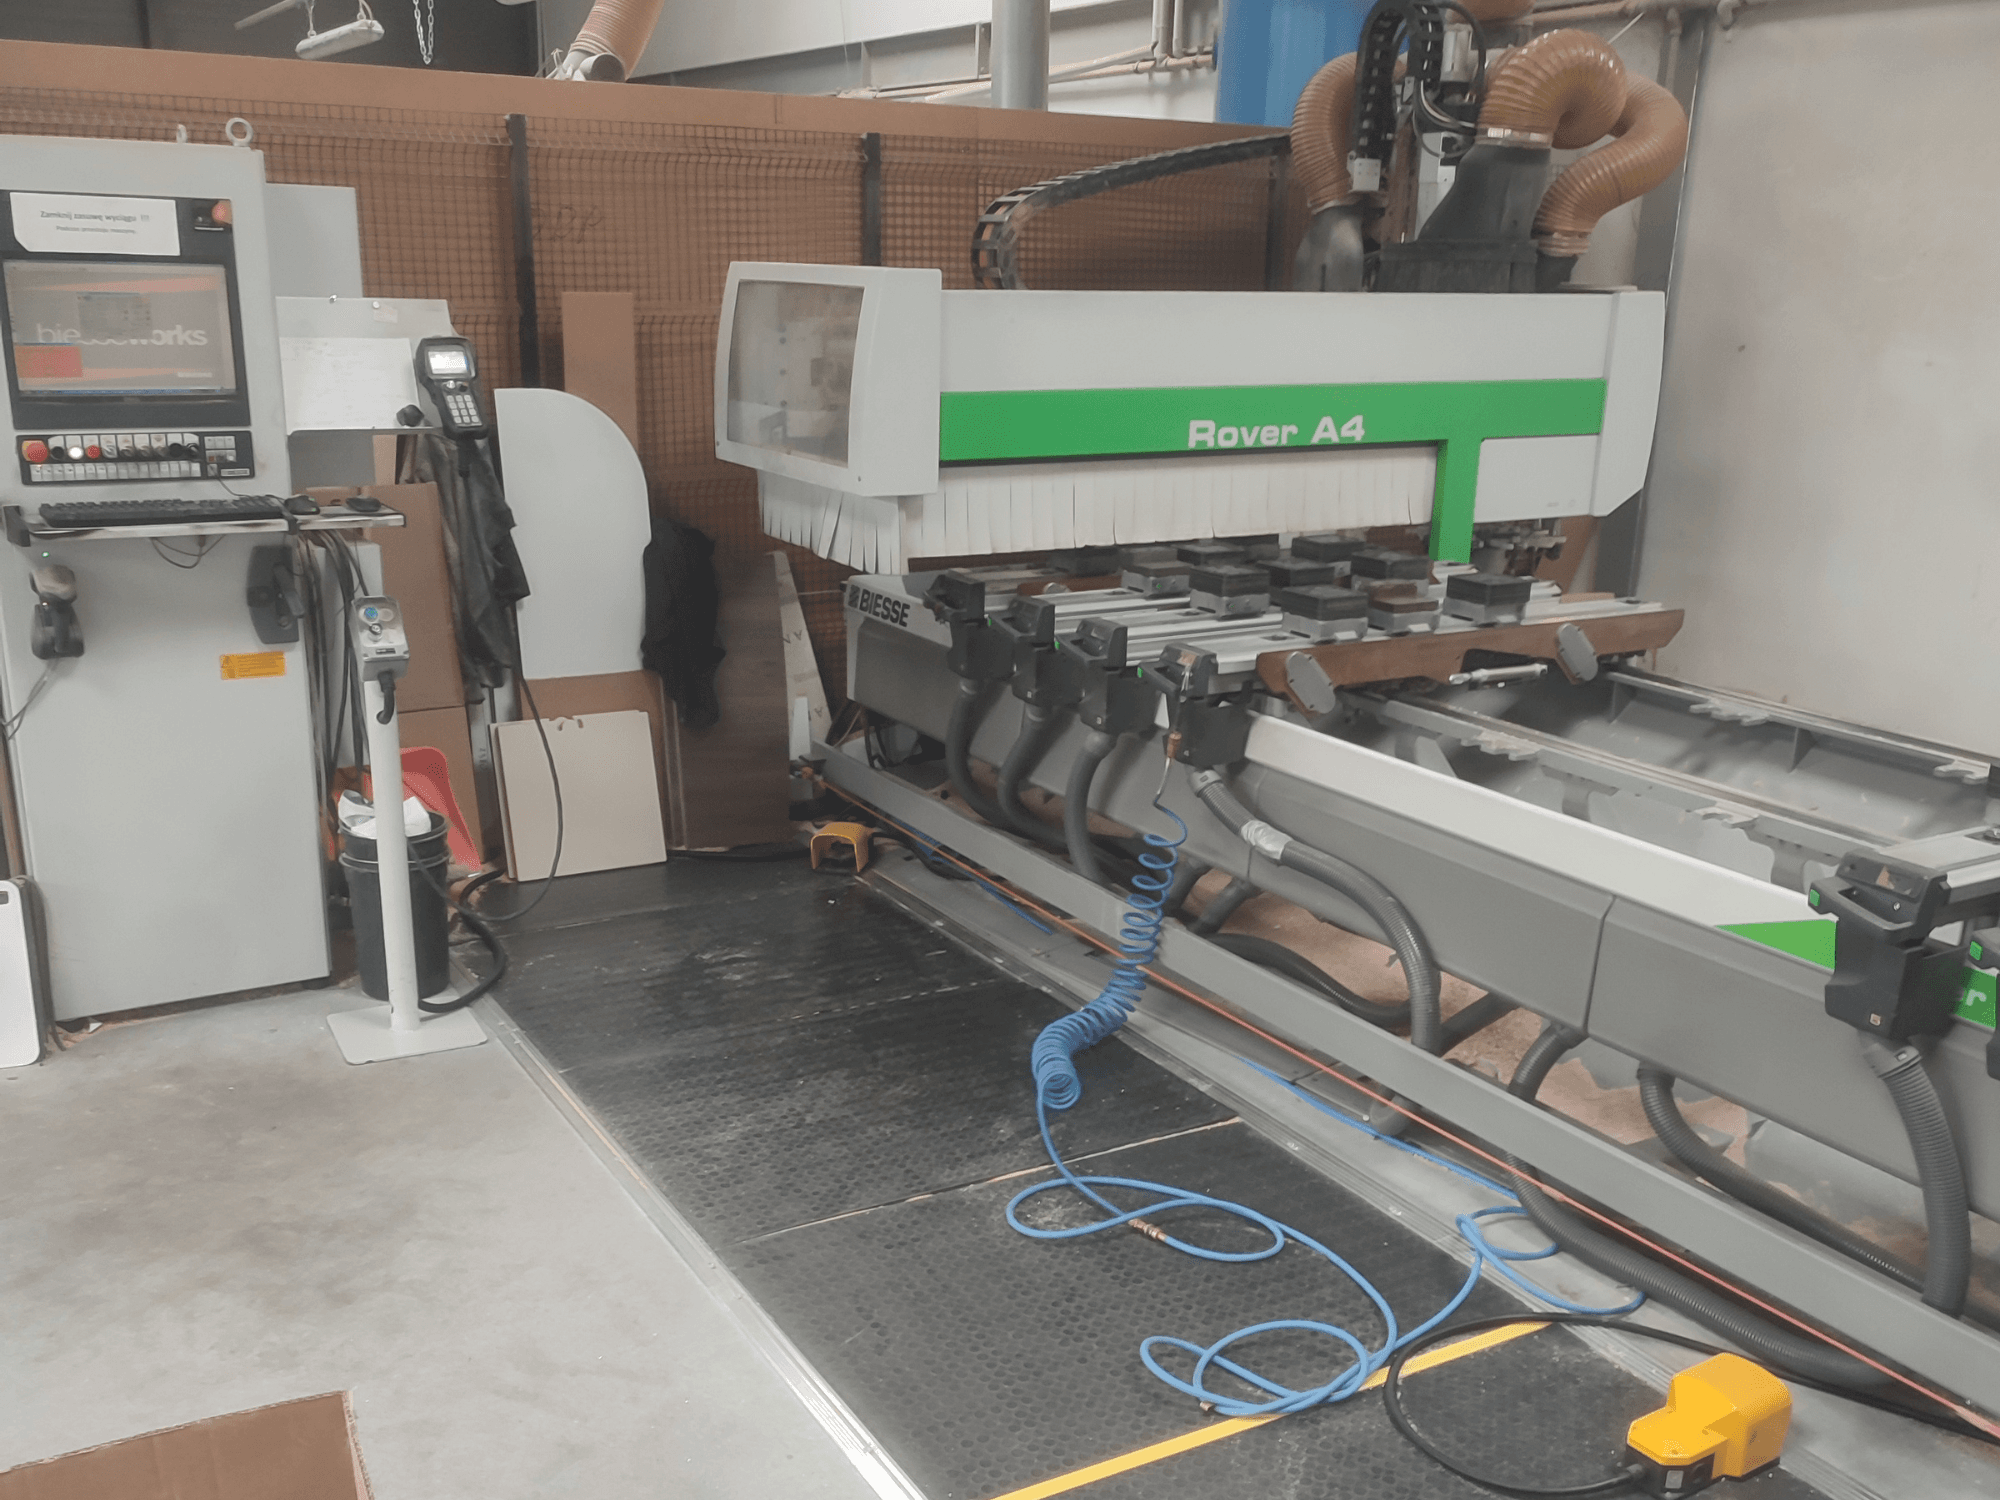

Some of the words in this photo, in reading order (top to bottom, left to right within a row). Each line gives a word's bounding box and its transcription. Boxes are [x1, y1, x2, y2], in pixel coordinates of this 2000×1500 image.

[40, 211, 72, 220] Zamknij
[1188, 419, 1299, 449] Rover
[1310, 414, 1366, 445] A4
[859, 588, 911, 628] BIESSE
